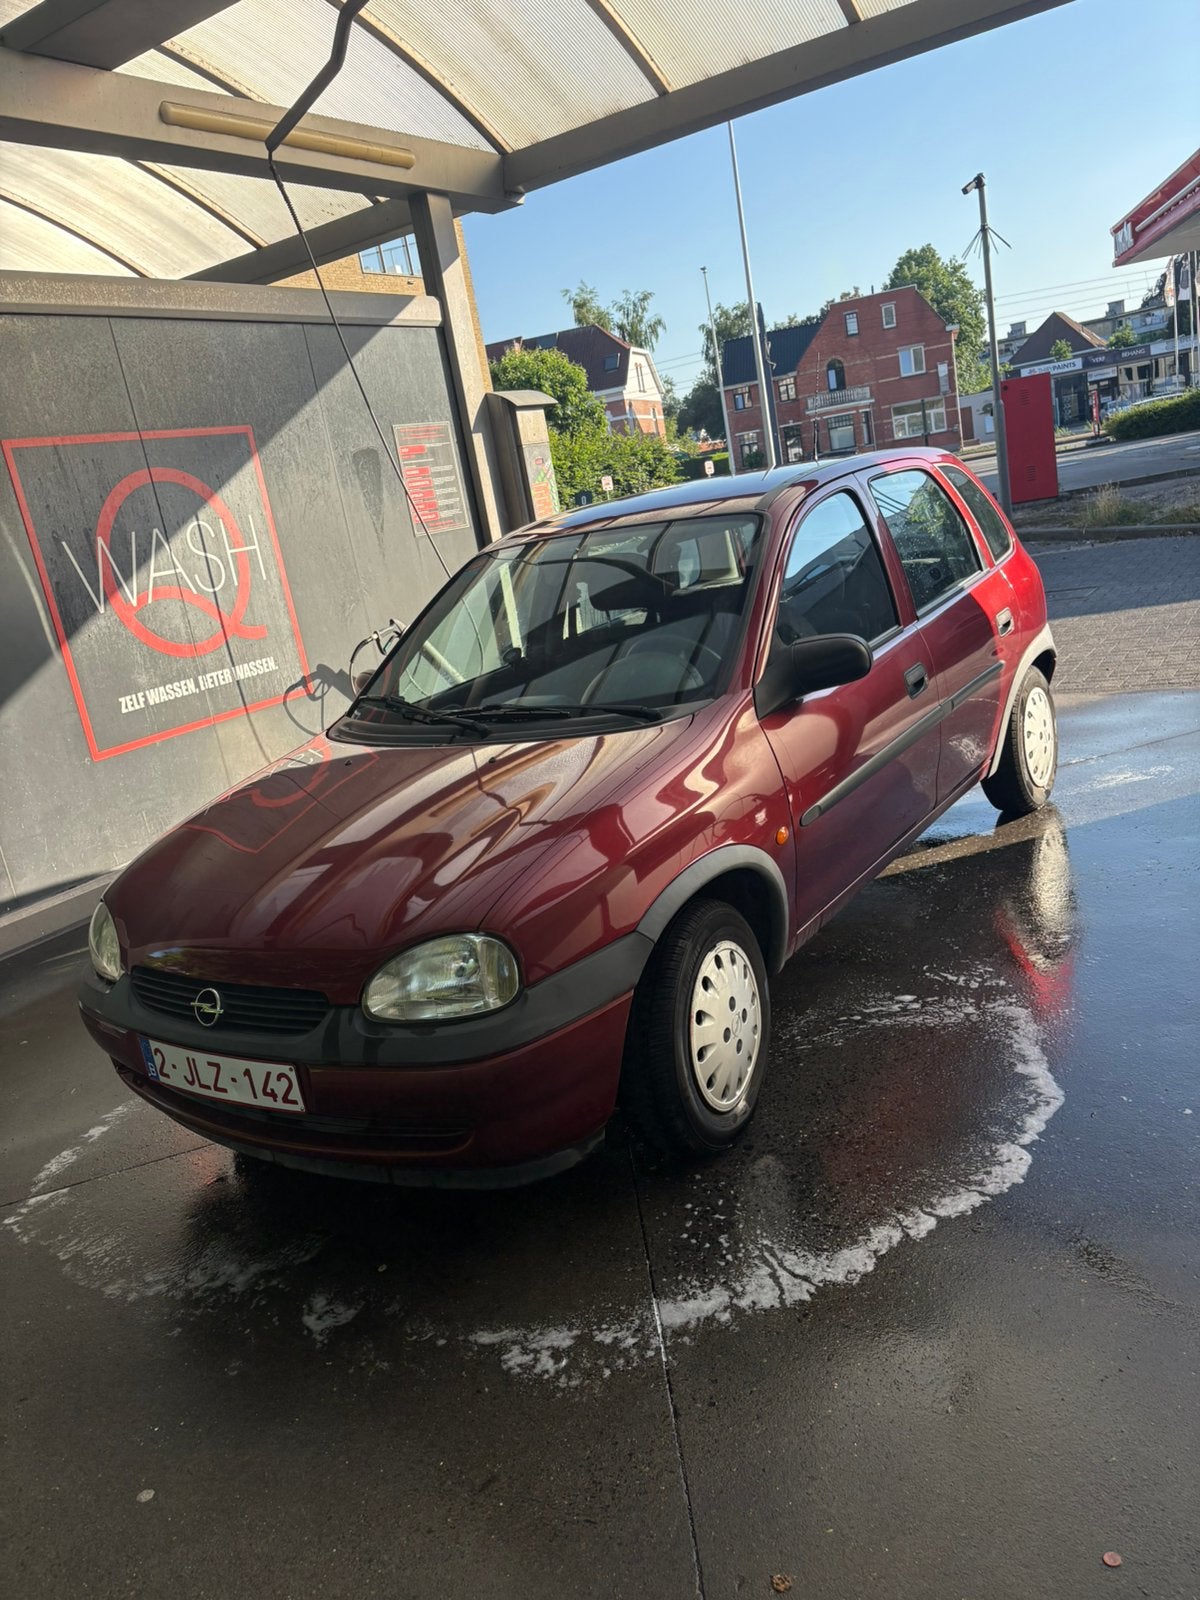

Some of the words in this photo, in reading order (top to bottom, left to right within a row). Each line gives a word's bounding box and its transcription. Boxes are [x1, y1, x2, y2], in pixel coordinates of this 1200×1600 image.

[1121, 348, 1146, 359] BEHANG
[62, 514, 267, 614] WASH
[95, 466, 268, 659] Q
[118, 693, 146, 714] ZELF
[146, 677, 200, 706] WASSEN,
[231, 656, 279, 682] WASSEN.
